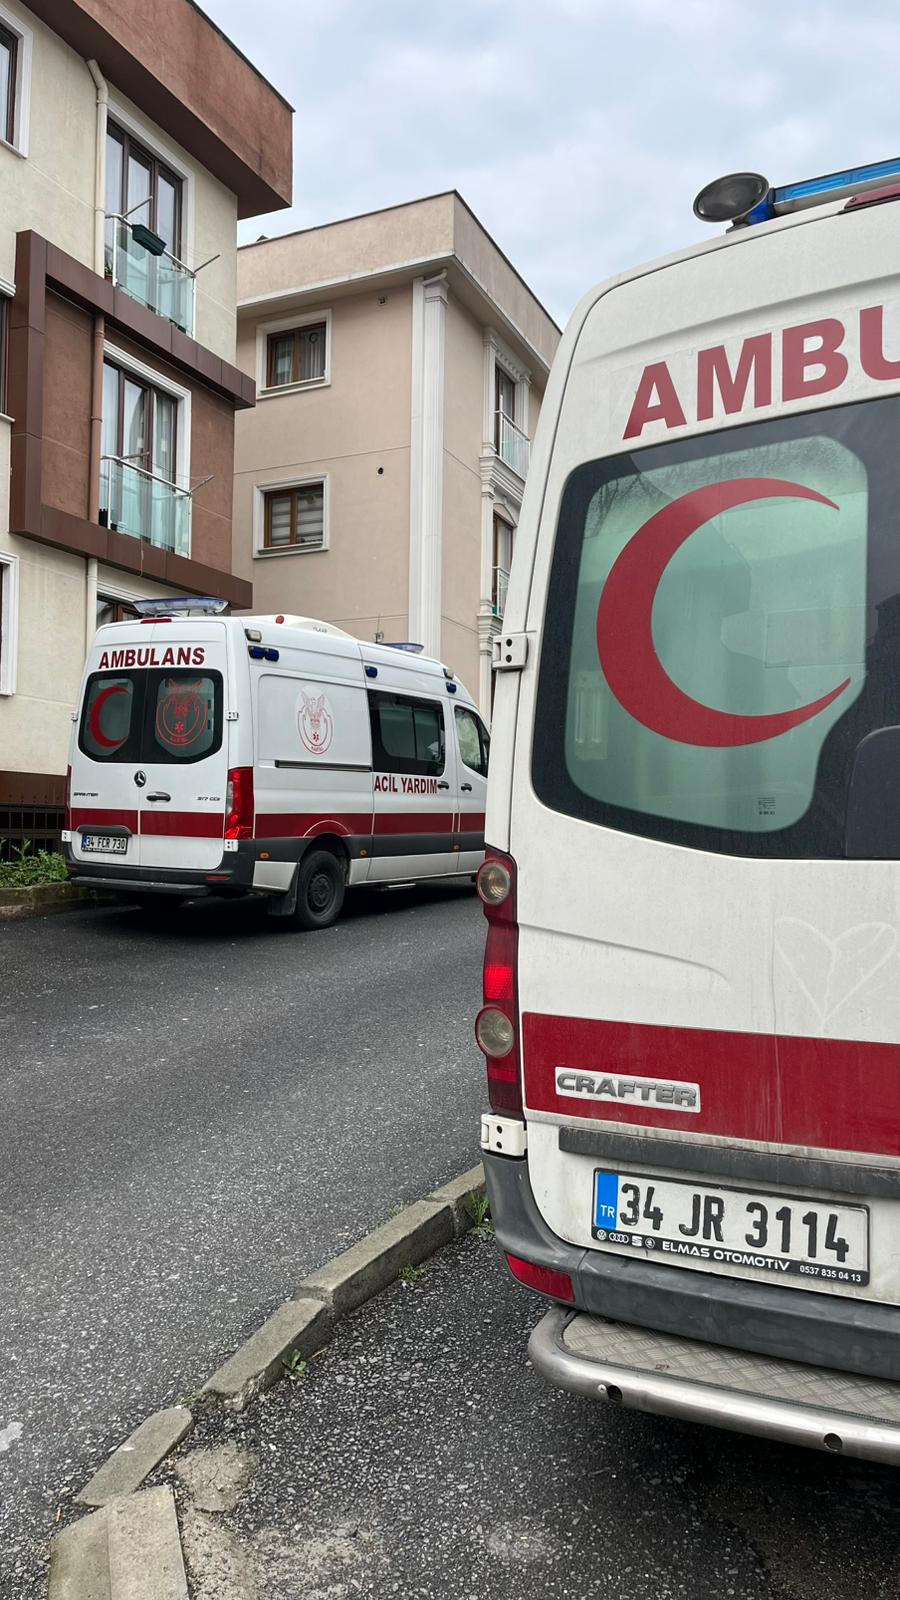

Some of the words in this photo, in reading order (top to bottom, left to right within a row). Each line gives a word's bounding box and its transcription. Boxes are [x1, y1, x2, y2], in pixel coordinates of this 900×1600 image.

[99, 647, 205, 669] AMBULANS
[374, 774, 398, 792] ACİL
[400, 777, 437, 793] YARDIM
[86, 836, 95, 848] 34
[97, 837, 111, 849] FCR
[112, 838, 126, 850] 730
[557, 1072, 697, 1107] CRAFTER
[600, 1204, 615, 1218] TR
[620, 1183, 663, 1230] 34
[679, 1194, 724, 1242] JR
[745, 1202, 849, 1262] 3114
[662, 1241, 710, 1258] ELMAS
[799, 1265, 818, 1275] 0537
[821, 1268, 837, 1278] 835
[838, 1271, 849, 1280] 04
[851, 1273, 862, 1283] 13
